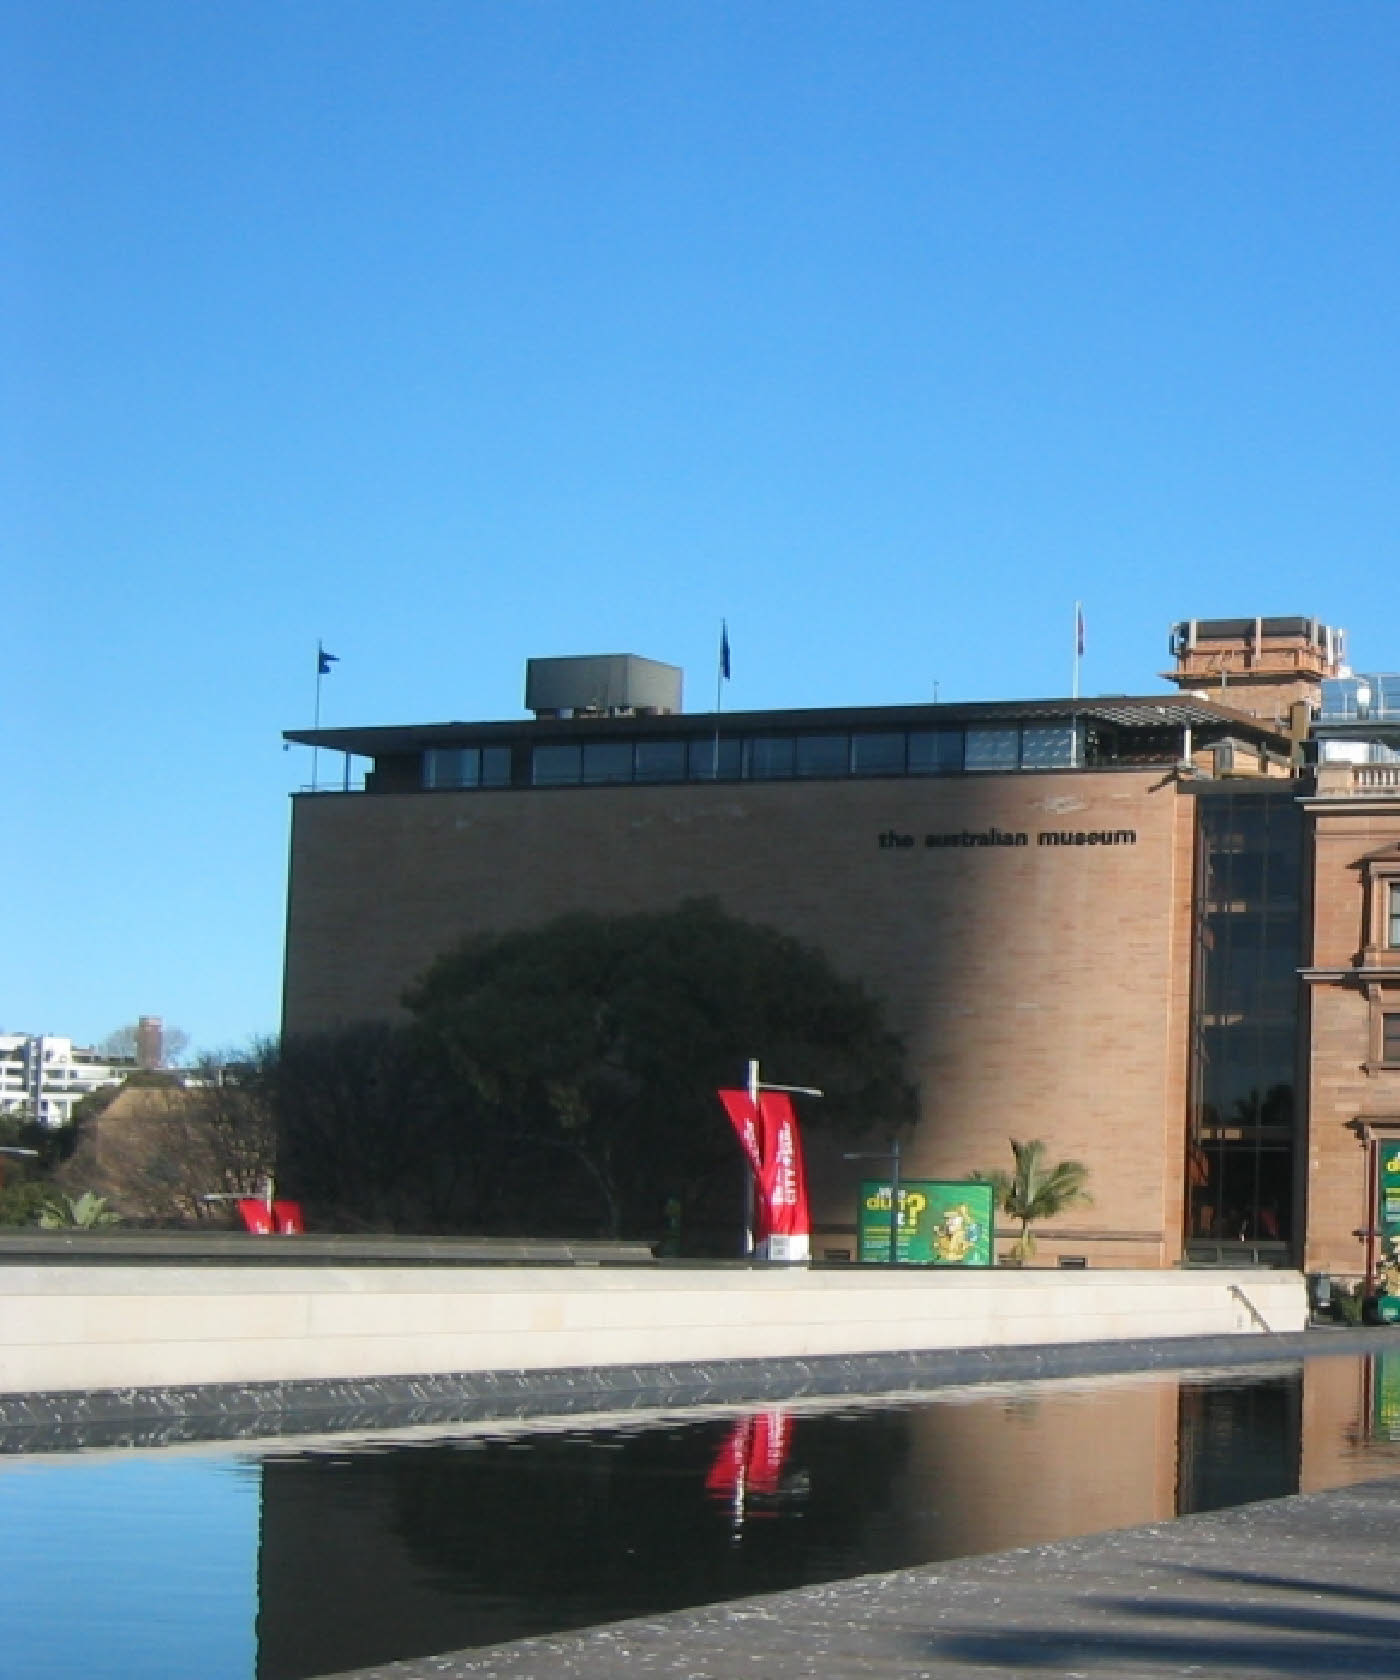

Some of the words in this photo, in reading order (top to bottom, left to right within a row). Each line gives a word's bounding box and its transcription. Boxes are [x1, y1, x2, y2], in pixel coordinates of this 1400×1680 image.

[878, 829, 914, 848] the
[925, 826, 1029, 848] australian
[1037, 829, 1137, 846] museum
